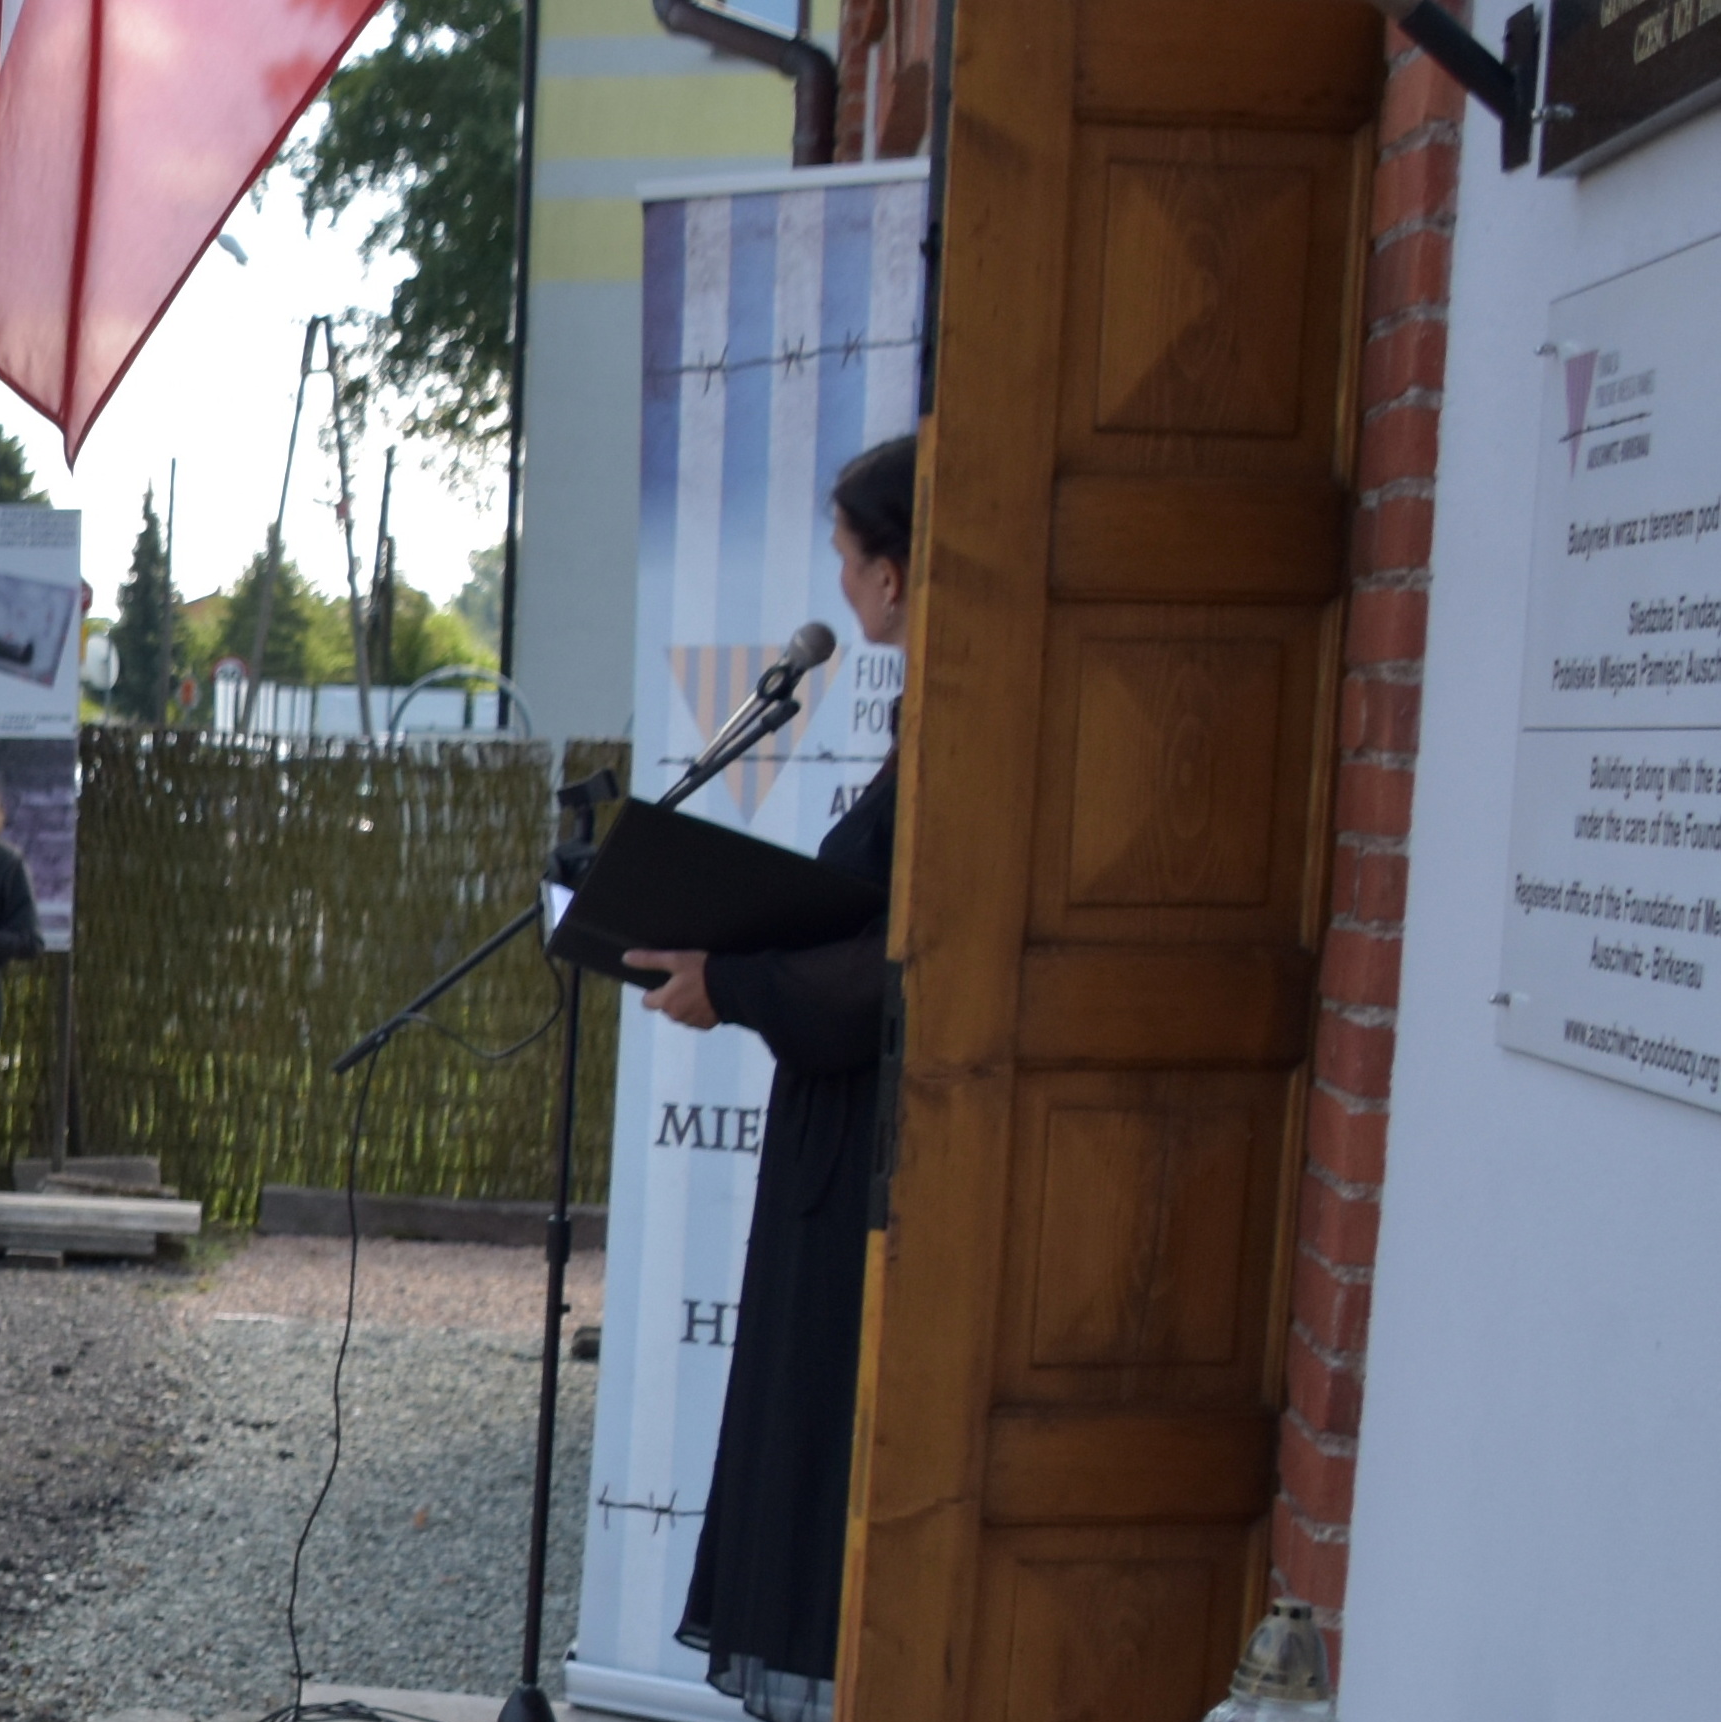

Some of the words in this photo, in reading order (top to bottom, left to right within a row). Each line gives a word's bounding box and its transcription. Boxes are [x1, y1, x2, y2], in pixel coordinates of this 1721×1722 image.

[1567, 518, 1611, 561] Budynek
[1613, 519, 1638, 547] wraz
[1639, 518, 1647, 543] z
[1649, 509, 1694, 541] terenem
[1695, 496, 1721, 543] pod
[1627, 599, 1673, 635] Siedziba
[1552, 656, 1596, 691] Pobliskie
[1597, 655, 1637, 697] Miejsca
[1639, 650, 1684, 695] Pamięci
[1590, 755, 1632, 800] Building
[1634, 757, 1665, 801] along
[1668, 757, 1691, 793] with
[1693, 757, 1714, 794] the
[1574, 808, 1604, 840] under
[1605, 808, 1622, 842] the
[1623, 817, 1647, 844] care
[1648, 809, 1663, 845] of
[1663, 810, 1681, 848] the
[1514, 873, 1563, 916] Registered
[1564, 880, 1591, 916] office
[1591, 884, 1605, 919] of
[1605, 885, 1622, 921] the
[1623, 887, 1685, 931] Foundation
[1687, 896, 1703, 932] of
[1589, 935, 1644, 977] Auschwitz
[1651, 945, 1705, 990] Birkenau
[655, 1102, 768, 1156] MIE
